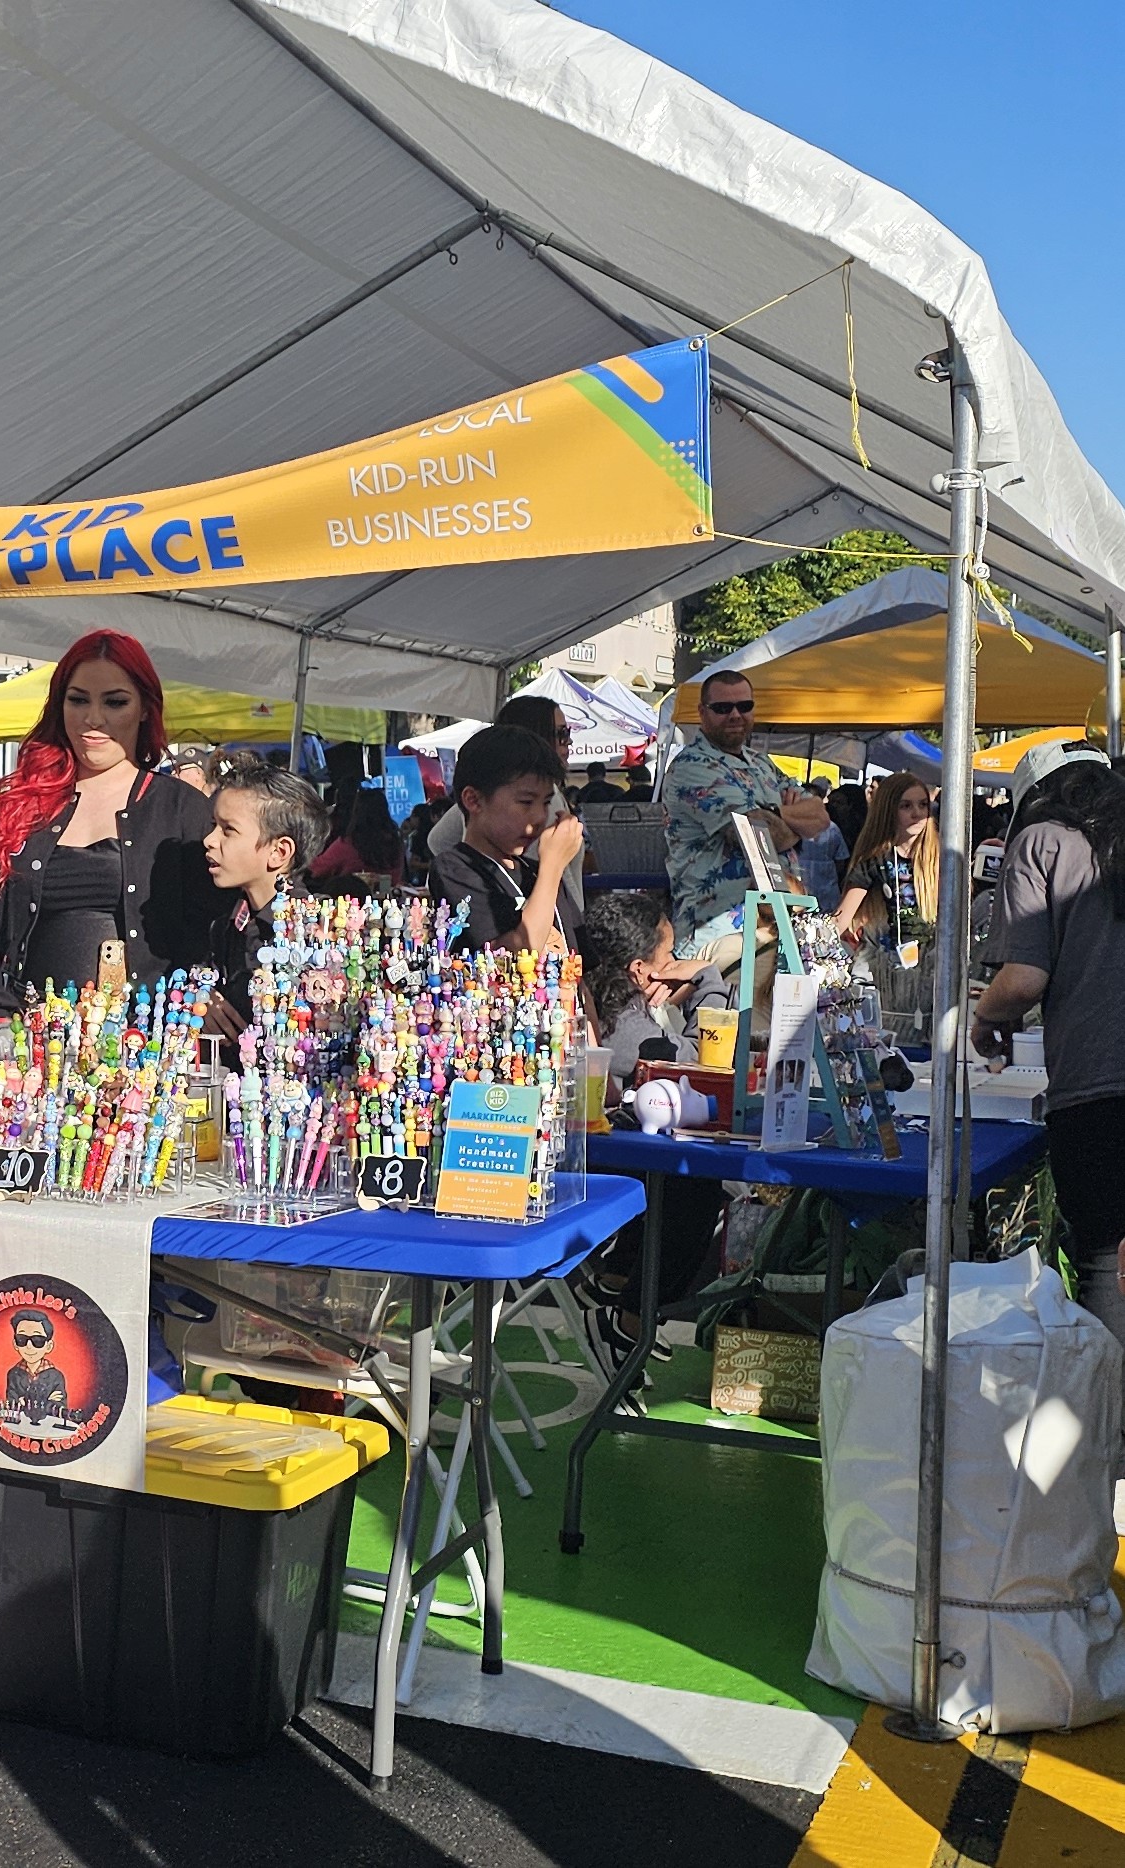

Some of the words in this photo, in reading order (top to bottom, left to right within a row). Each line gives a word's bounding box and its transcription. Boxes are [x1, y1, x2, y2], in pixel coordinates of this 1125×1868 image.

[348, 450, 497, 497] KID-RUN
[2, 502, 144, 542] KID
[327, 497, 532, 548] BUSINESSES
[461, 1111, 528, 1124] MARKETPLACE
[489, 1097, 504, 1105] KID
[458, 1145, 518, 1159] Handmade
[474, 1134, 505, 1146] Leo's
[373, 1160, 404, 1196] $8
[458, 1157, 515, 1171] Creations
[36, 1287, 78, 1320] Leo's
[42, 1403, 111, 1454] Creations
